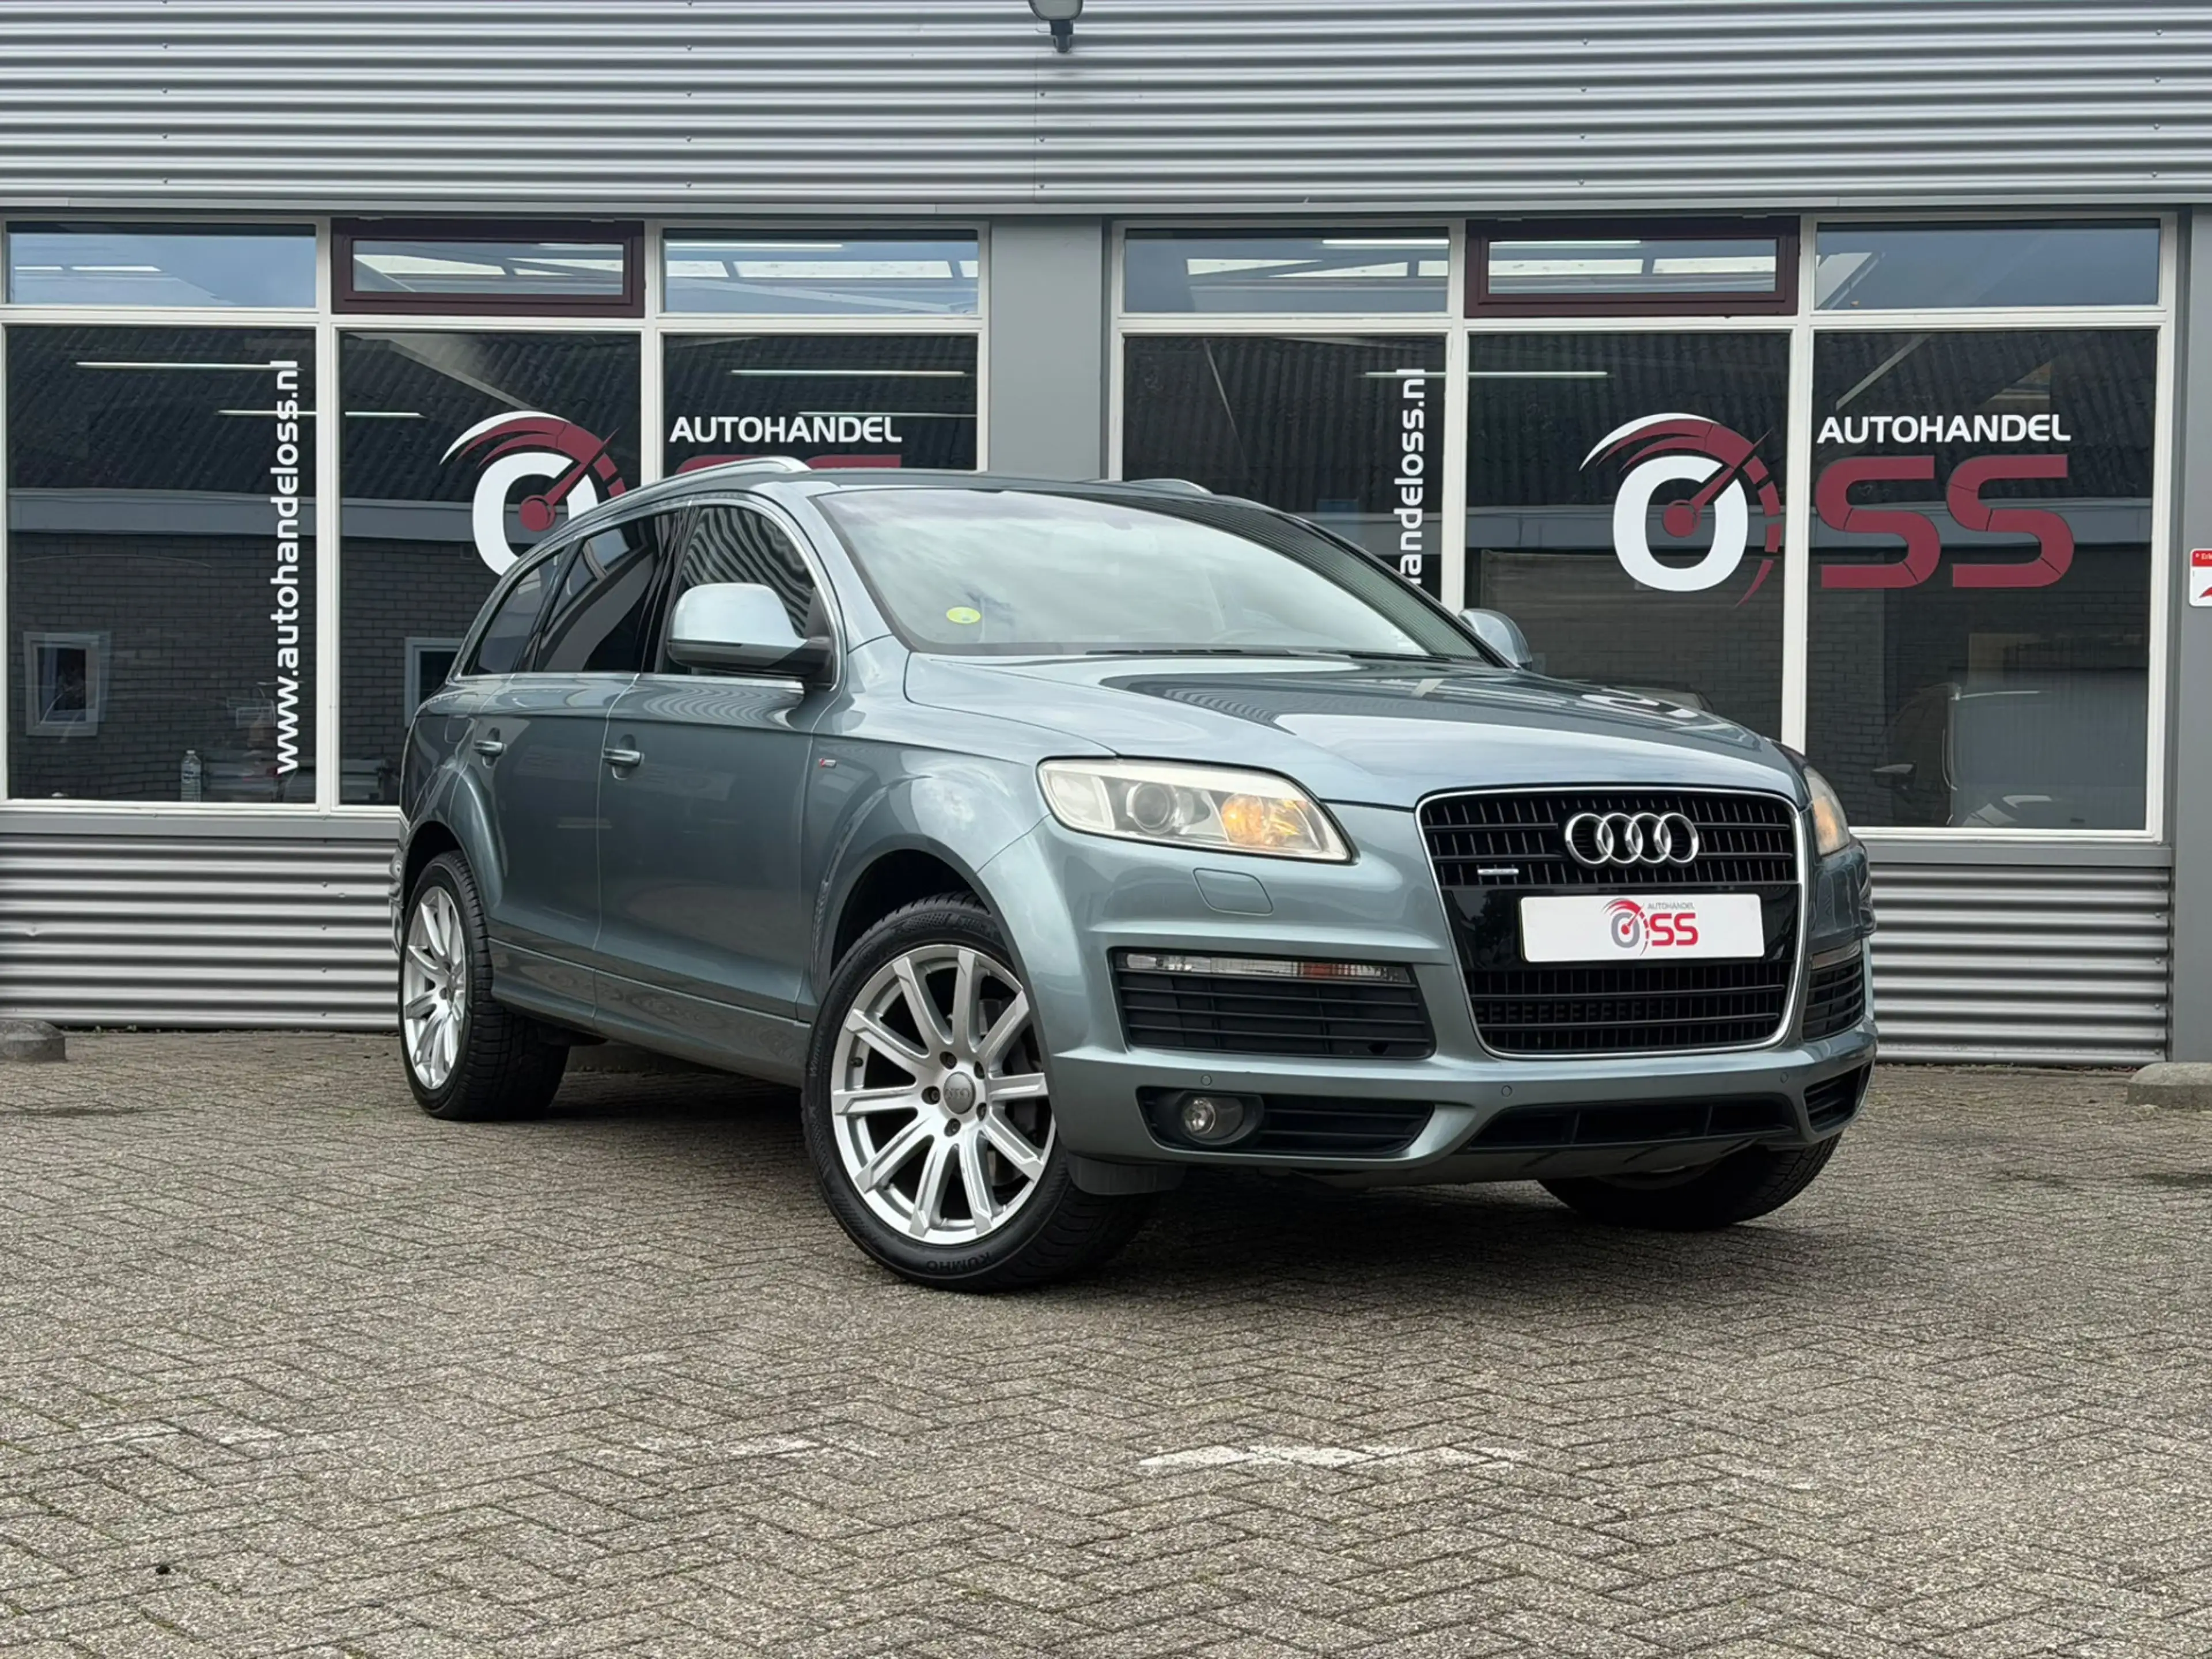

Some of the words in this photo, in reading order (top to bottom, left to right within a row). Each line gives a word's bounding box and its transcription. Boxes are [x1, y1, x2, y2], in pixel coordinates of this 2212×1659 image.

[669, 416, 902, 443] AUTOHANDEL
[1394, 369, 1426, 585] andeloss.nl
[1817, 414, 2071, 444] AUTOHANDEL
[270, 361, 299, 774] www.autohandeloss.nl
